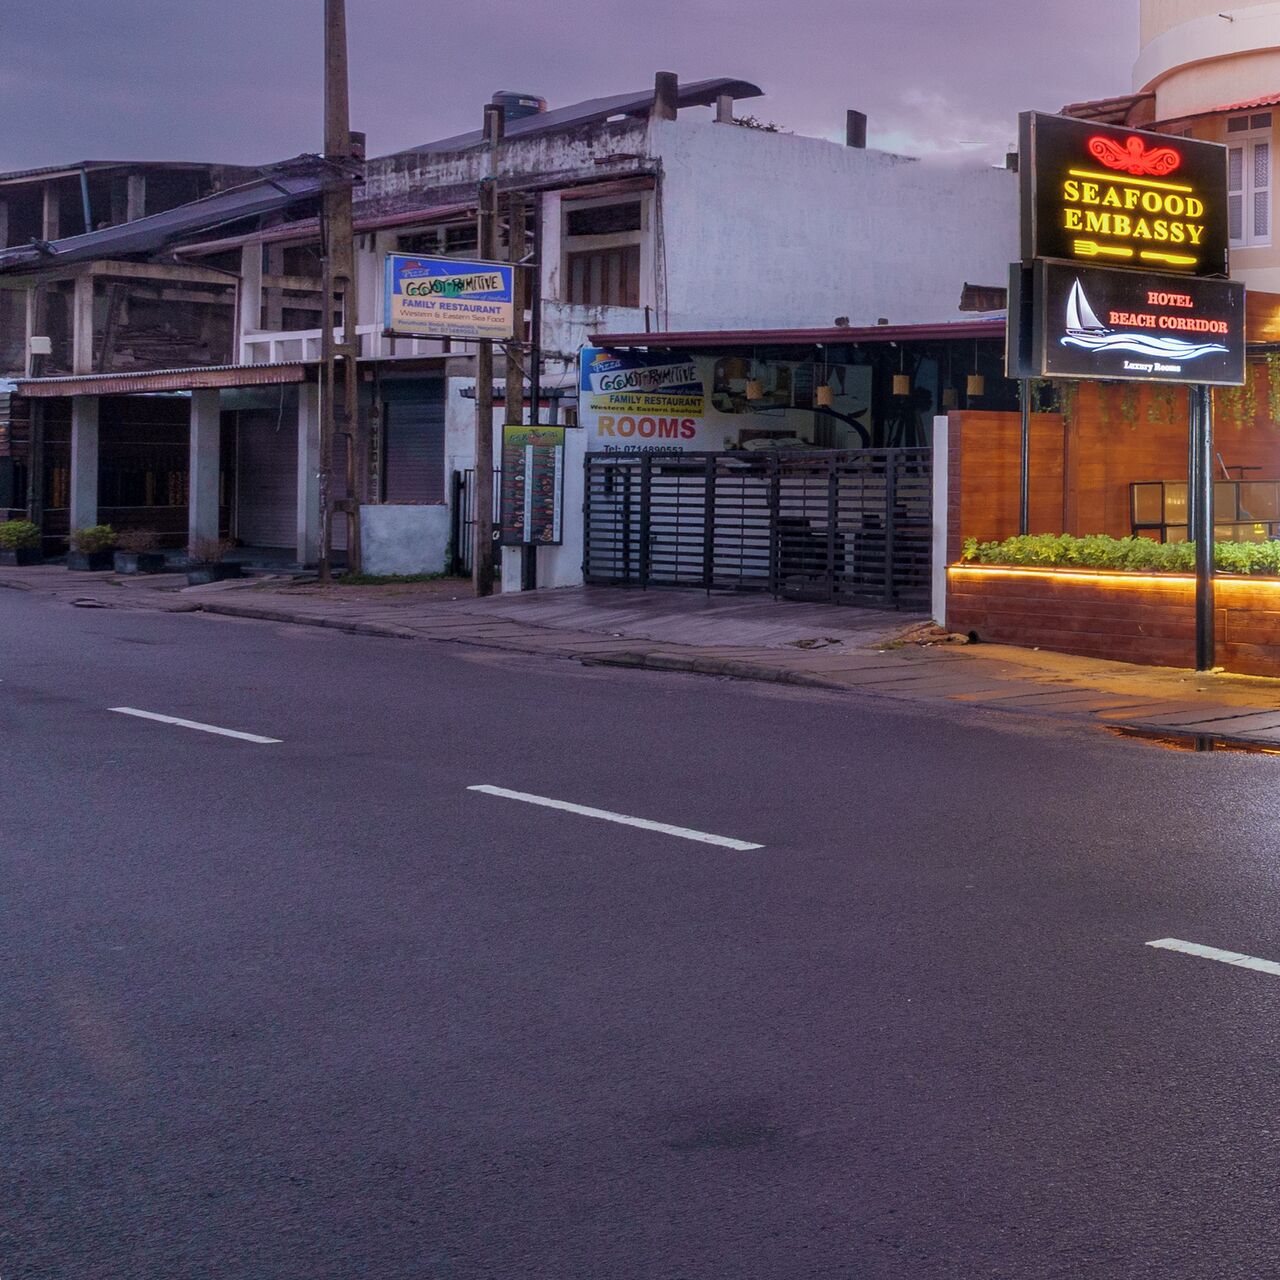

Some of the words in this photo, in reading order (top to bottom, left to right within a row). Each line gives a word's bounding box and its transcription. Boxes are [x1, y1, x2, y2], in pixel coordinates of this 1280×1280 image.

[1064, 180, 1204, 218] SEAFOOD
[1064, 208, 1204, 245] EMBASSY
[402, 299, 435, 310] FAMILY
[439, 302, 502, 314] RESTAURANT
[1147, 292, 1193, 308] HOTEL
[400, 310, 432, 318] Western
[443, 312, 470, 320] Eastern
[1109, 311, 1156, 328] BEACH
[1159, 315, 1228, 334] CORRIDOR
[593, 360, 622, 372] Pizza
[1123, 361, 1153, 372] Luxury
[1154, 363, 1181, 372] Rooms
[610, 395, 642, 405] FAMILY
[644, 396, 701, 407] RESTAURANT
[597, 415, 696, 439] ROOMS
